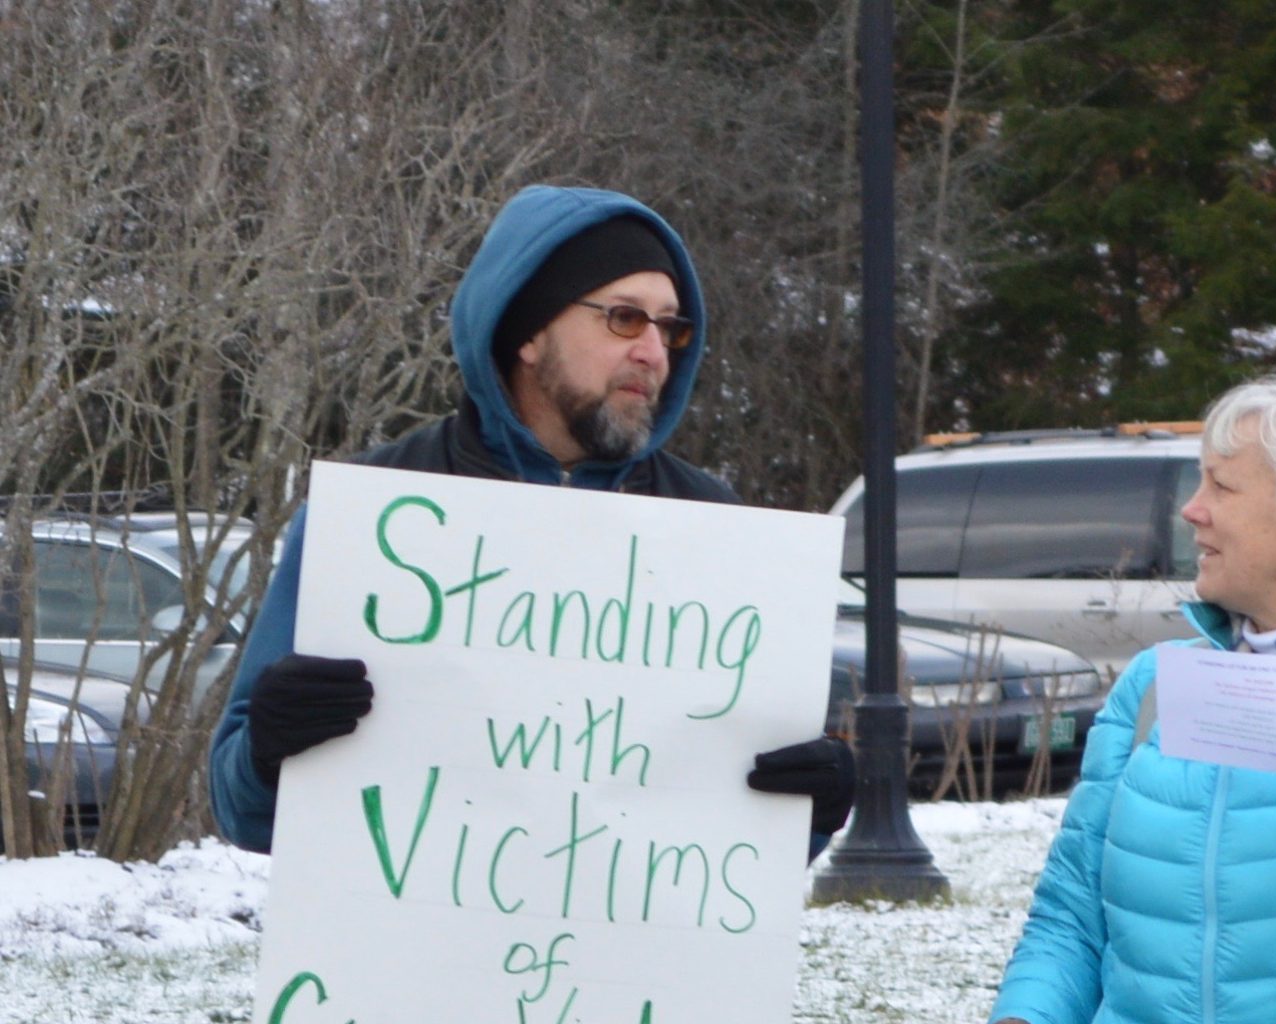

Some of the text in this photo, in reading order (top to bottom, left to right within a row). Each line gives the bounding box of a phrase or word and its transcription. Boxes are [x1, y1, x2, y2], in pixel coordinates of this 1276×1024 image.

[362, 495, 761, 720] Standing
[487, 696, 651, 787] with
[361, 766, 760, 933] Victims
[503, 934, 575, 1002] of
